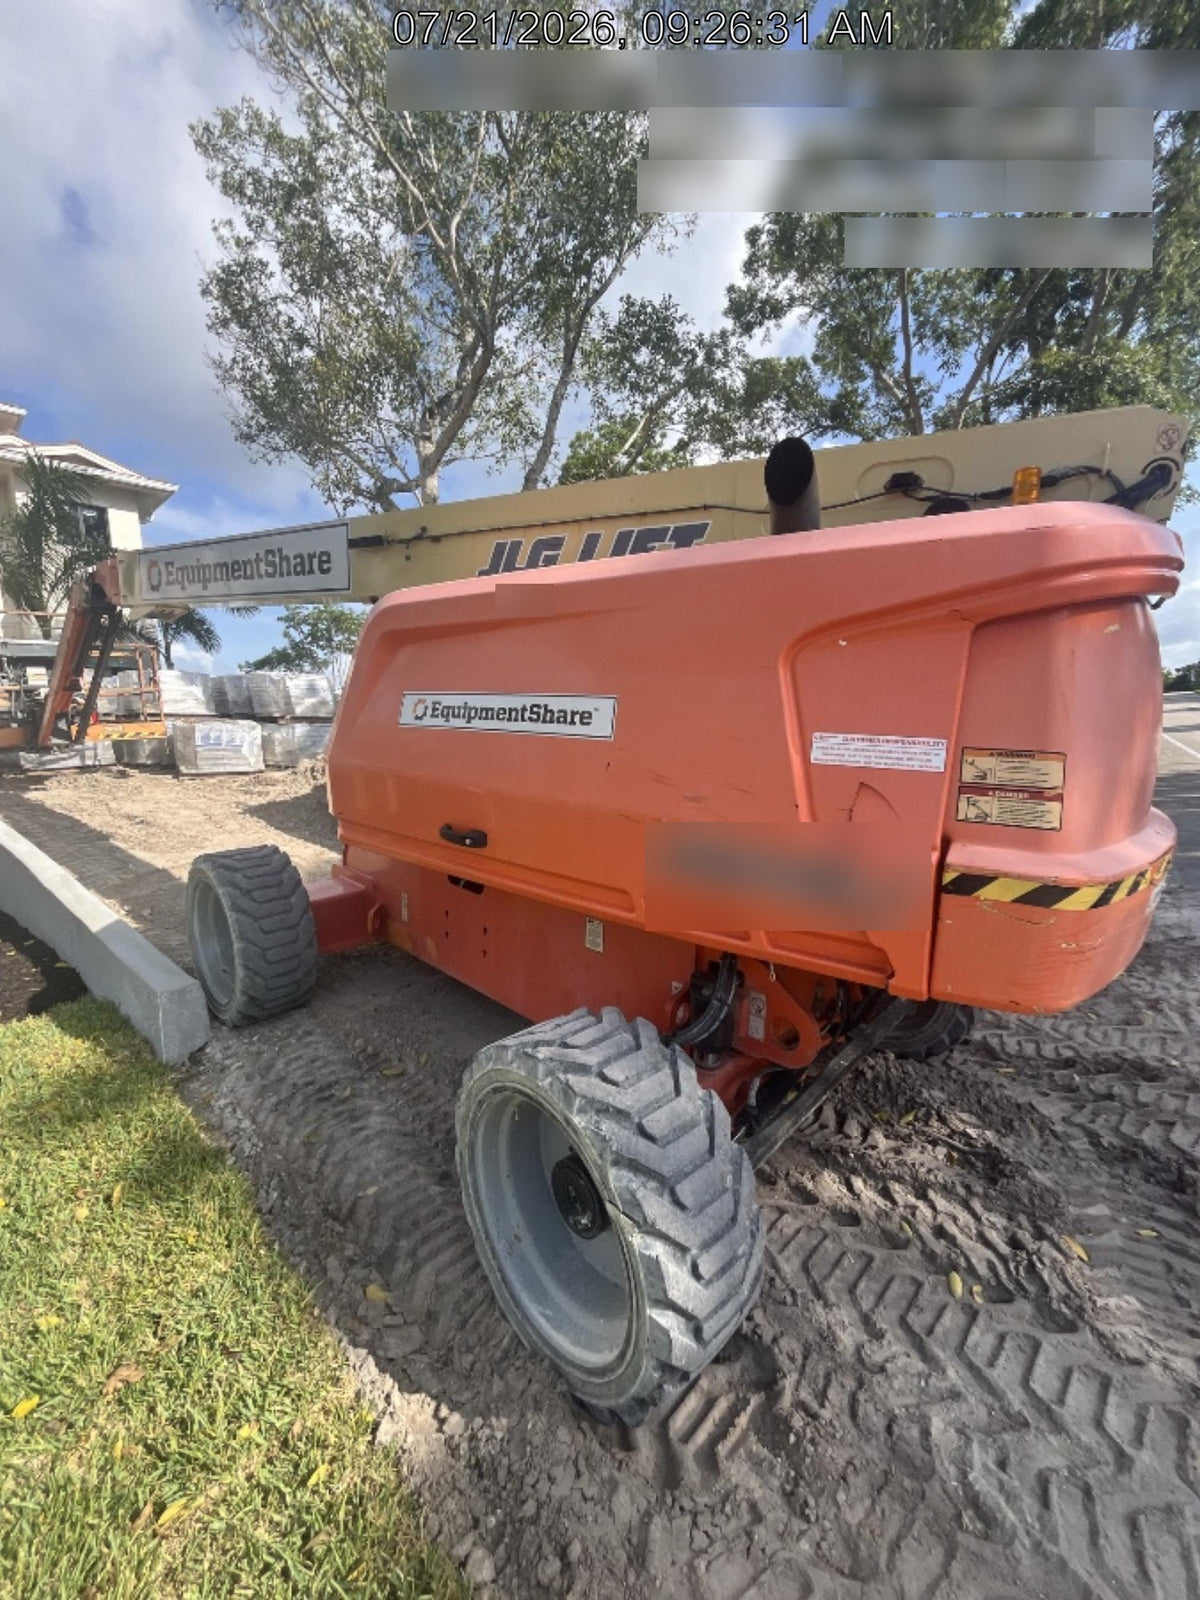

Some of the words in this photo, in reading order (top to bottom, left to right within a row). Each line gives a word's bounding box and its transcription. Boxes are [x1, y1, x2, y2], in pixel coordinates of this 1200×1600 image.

[164, 547, 332, 591] EquipmentShare
[476, 534, 568, 577] JLG
[430, 701, 593, 726] EquipmentShare
